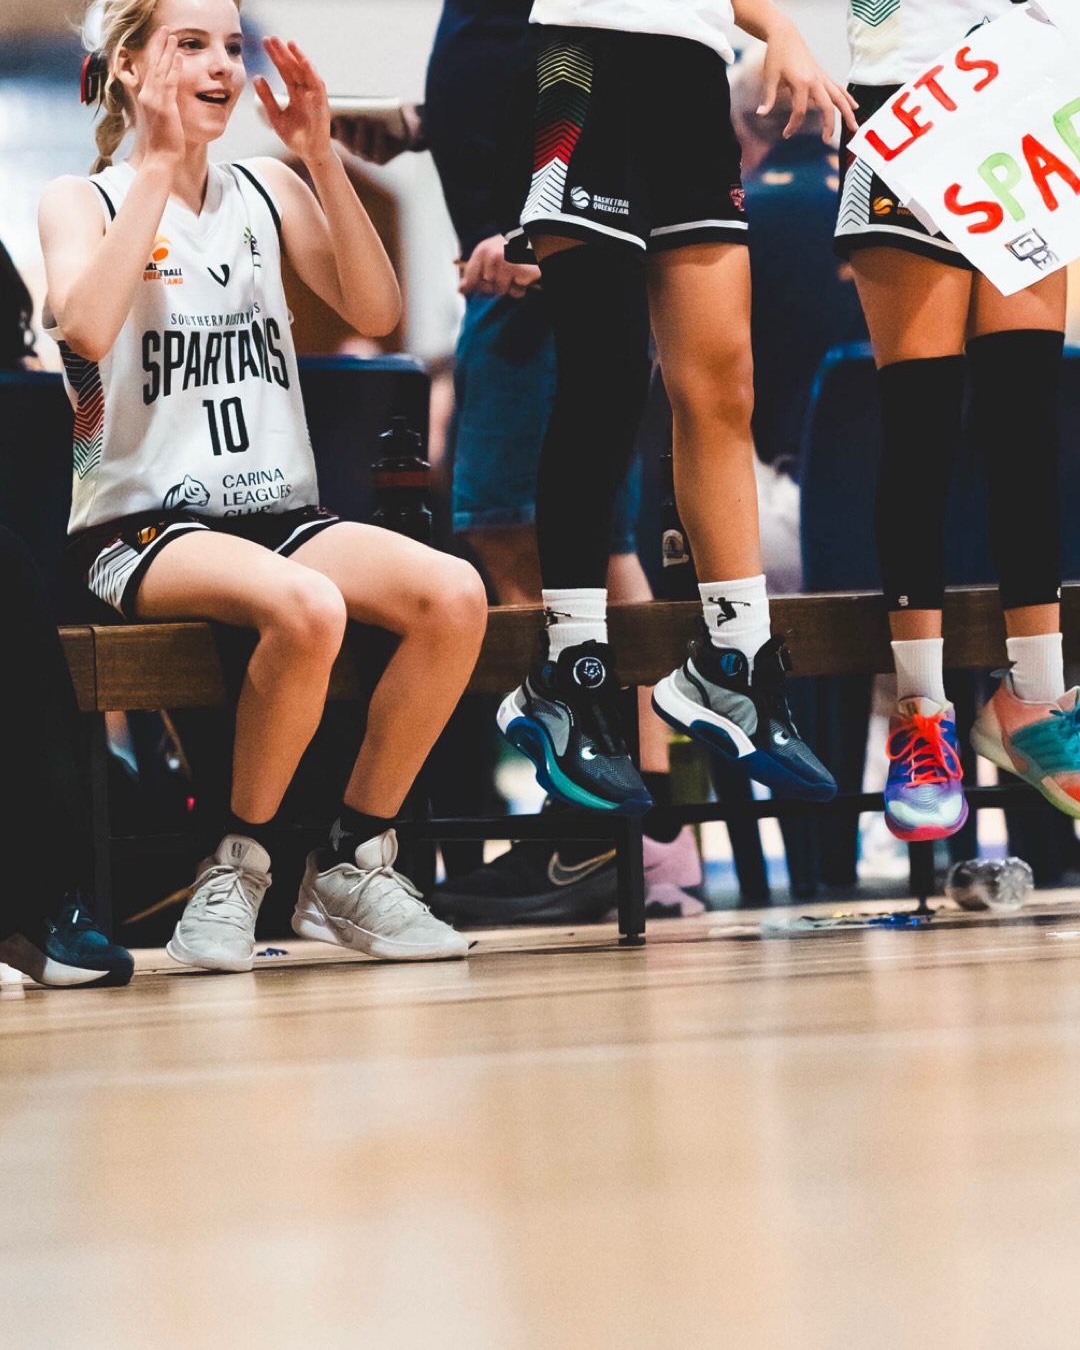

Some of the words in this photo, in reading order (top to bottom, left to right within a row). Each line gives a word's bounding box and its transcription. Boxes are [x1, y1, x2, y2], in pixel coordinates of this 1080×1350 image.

[864, 46, 1000, 161] LETS
[170, 313, 224, 327] SOUTHERN
[142, 317, 291, 406] SPARTANS
[202, 396, 250, 457] 10
[222, 468, 285, 489] CARINA
[223, 484, 292, 507] LEAGUES
